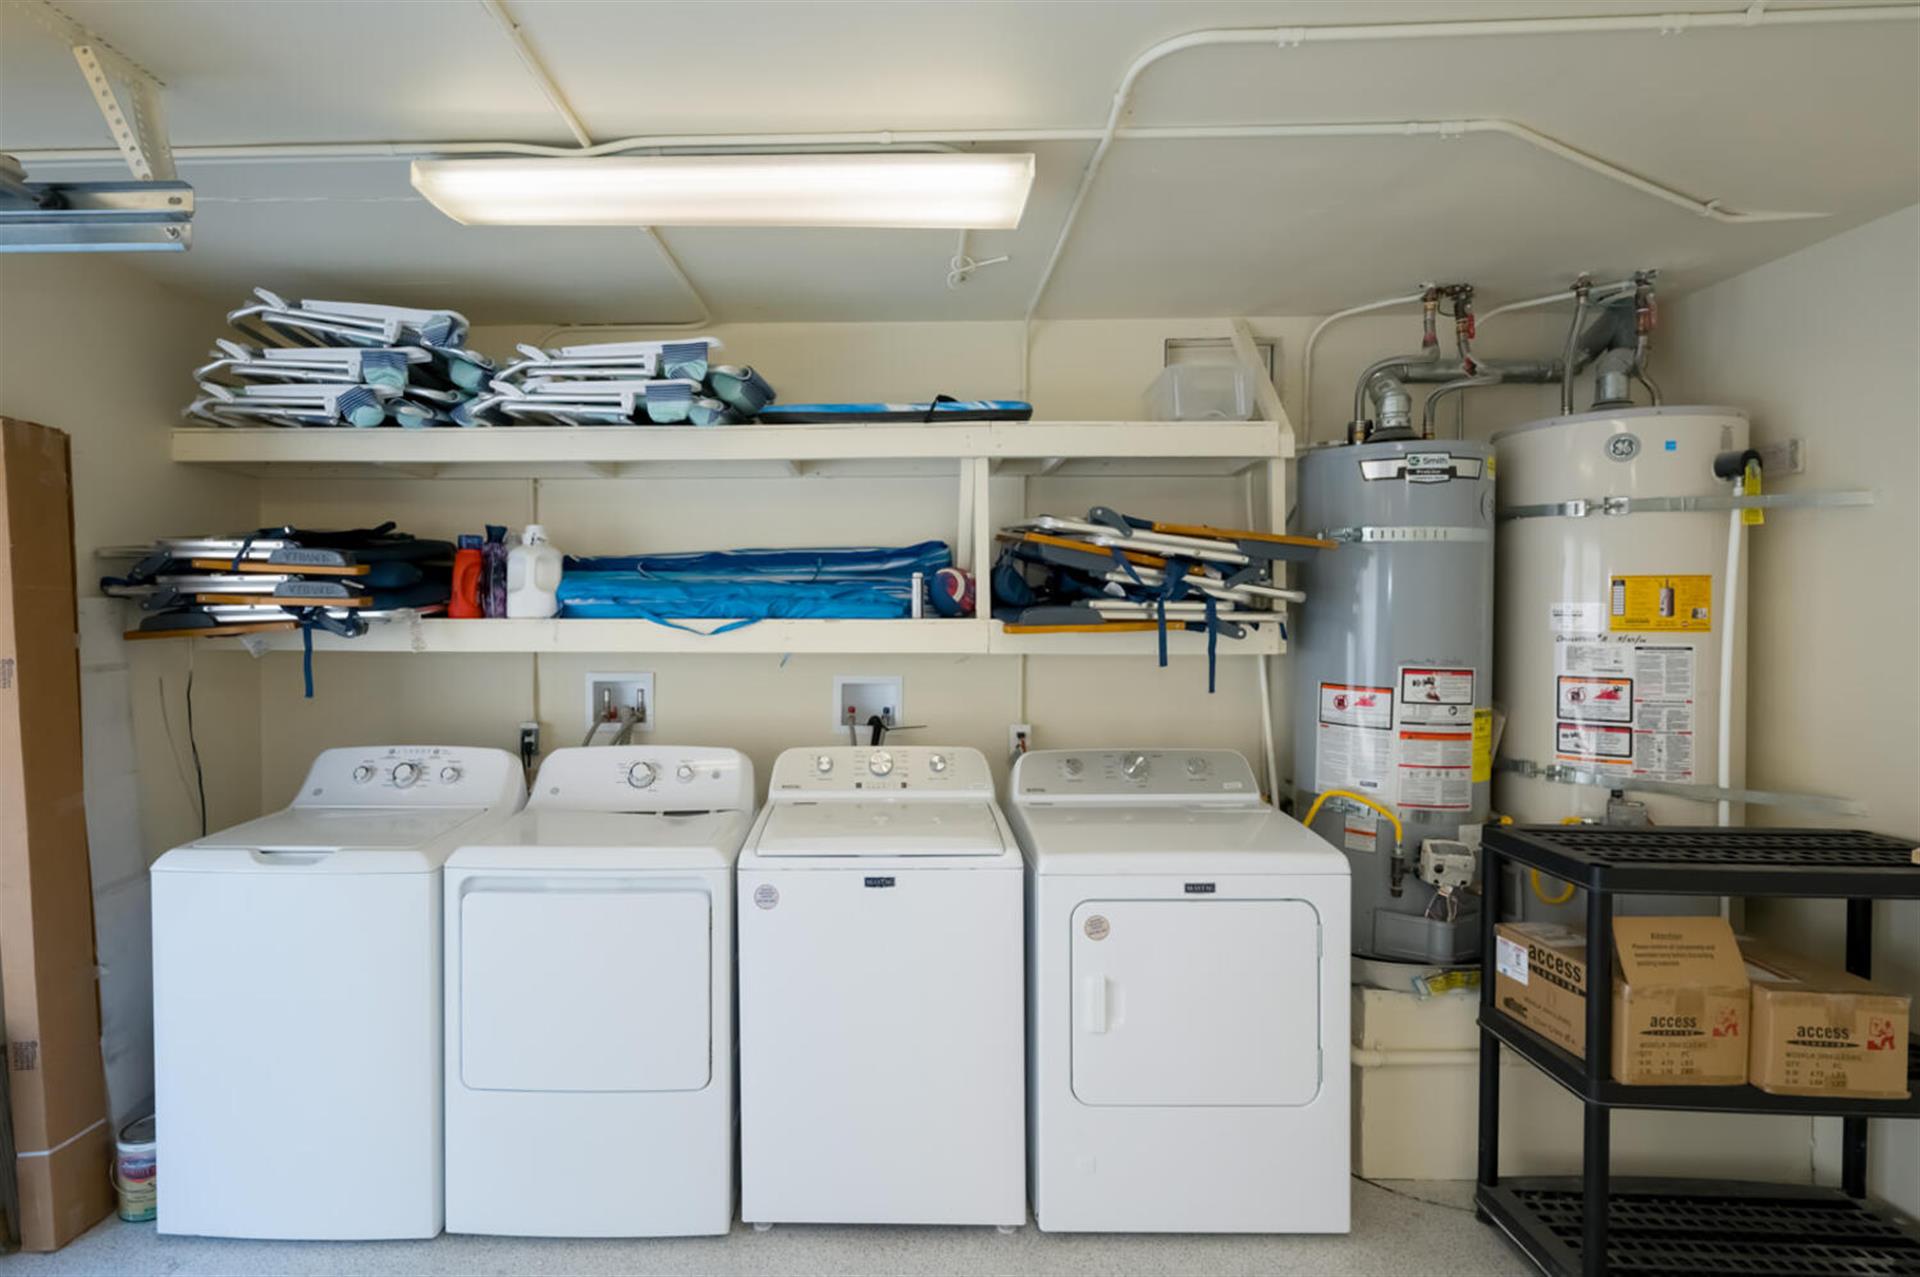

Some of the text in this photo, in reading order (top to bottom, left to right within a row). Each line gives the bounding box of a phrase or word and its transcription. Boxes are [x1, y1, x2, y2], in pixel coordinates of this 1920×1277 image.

[1423, 456, 1448, 465] Smith
[1528, 944, 1582, 983] access
[1650, 1015, 1697, 1028] access
[1796, 1025, 1850, 1040] access
